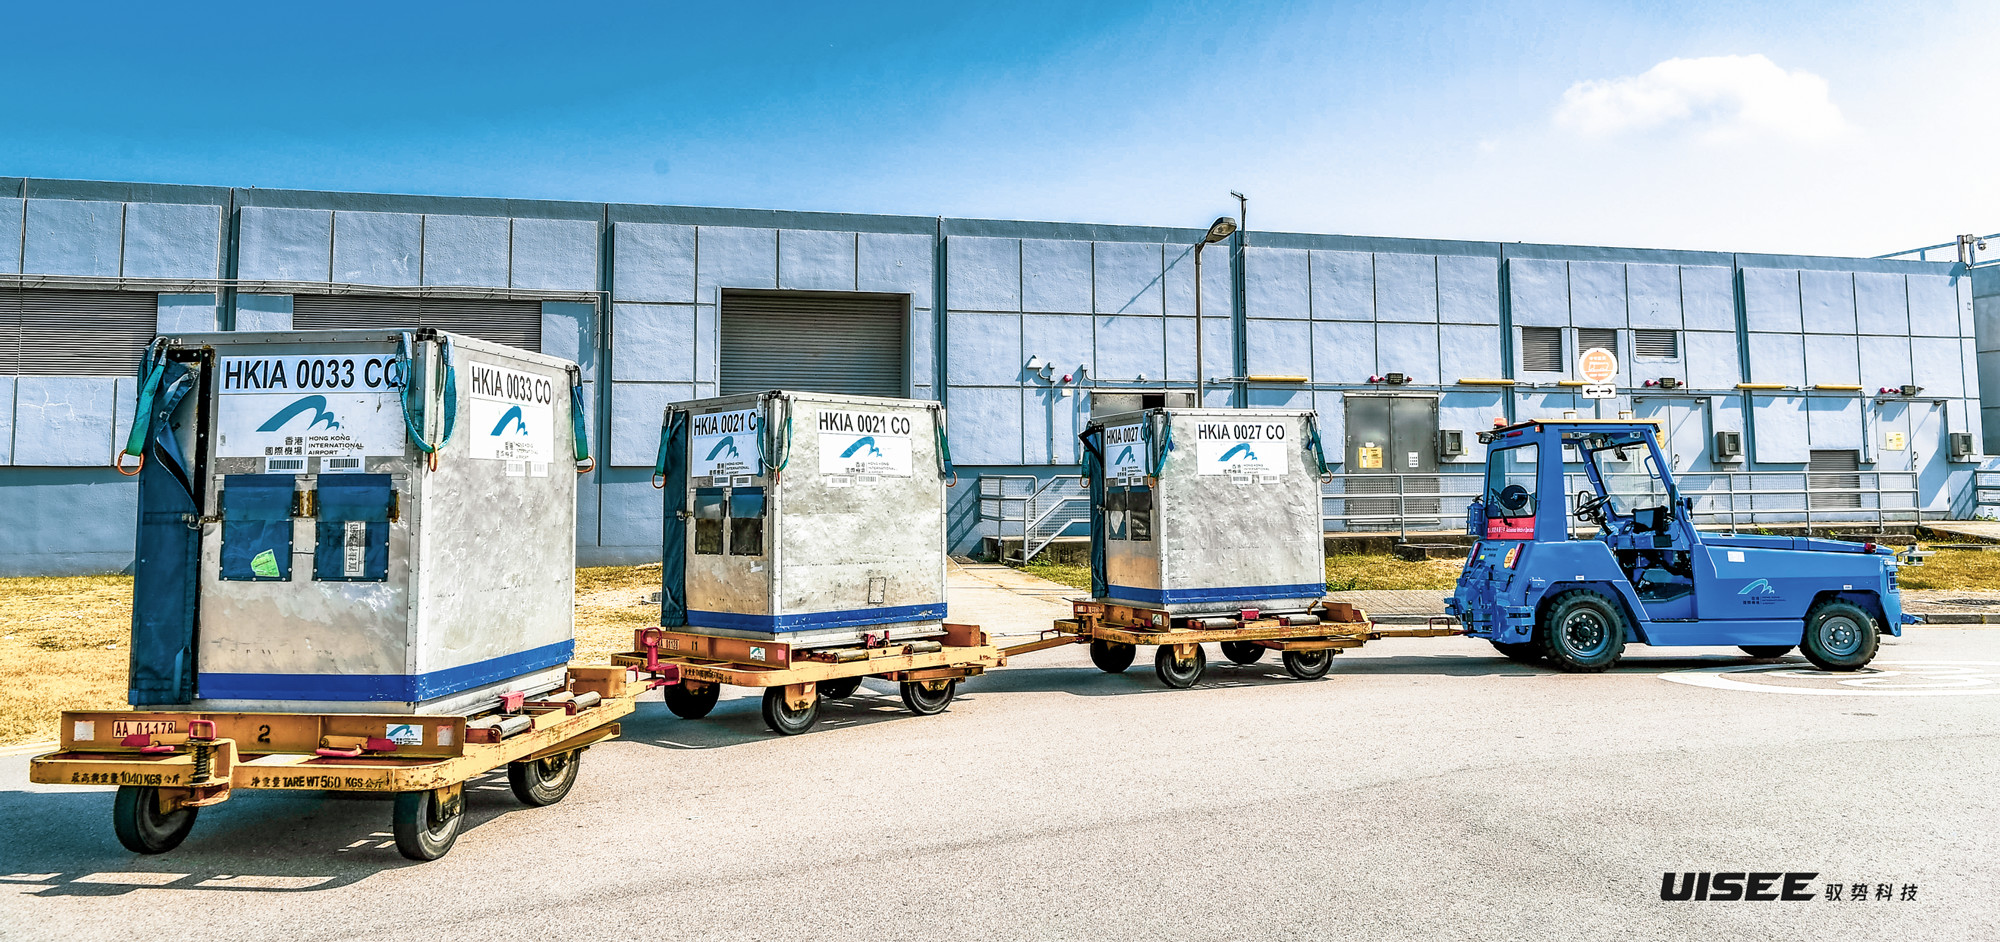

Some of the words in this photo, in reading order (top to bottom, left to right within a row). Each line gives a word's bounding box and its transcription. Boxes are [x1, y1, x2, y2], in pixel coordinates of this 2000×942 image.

[225, 359, 287, 389] HKIA
[296, 359, 355, 388] 0033
[472, 366, 503, 397] HKIA
[506, 373, 532, 401] 0033
[535, 378, 551, 405] CO
[694, 416, 718, 436] HKIA
[720, 413, 745, 433] 0021
[819, 411, 854, 431] HKIA
[857, 415, 886, 433] 0021
[891, 416, 910, 435] CO
[1198, 424, 1231, 440] HKIA
[1233, 424, 1262, 440] 0027
[1266, 424, 1285, 440] CO
[1106, 428, 1122, 445] HKIA
[1123, 426, 1139, 443] 0027
[115, 722, 129, 736] AA
[257, 724, 271, 743] 2
[120, 771, 143, 784] 1040
[144, 774, 162, 785] KGS
[283, 776, 305, 787] TARE
[306, 776, 320, 787] WT
[320, 775, 341, 788] 560
[345, 777, 363, 787] KGS
